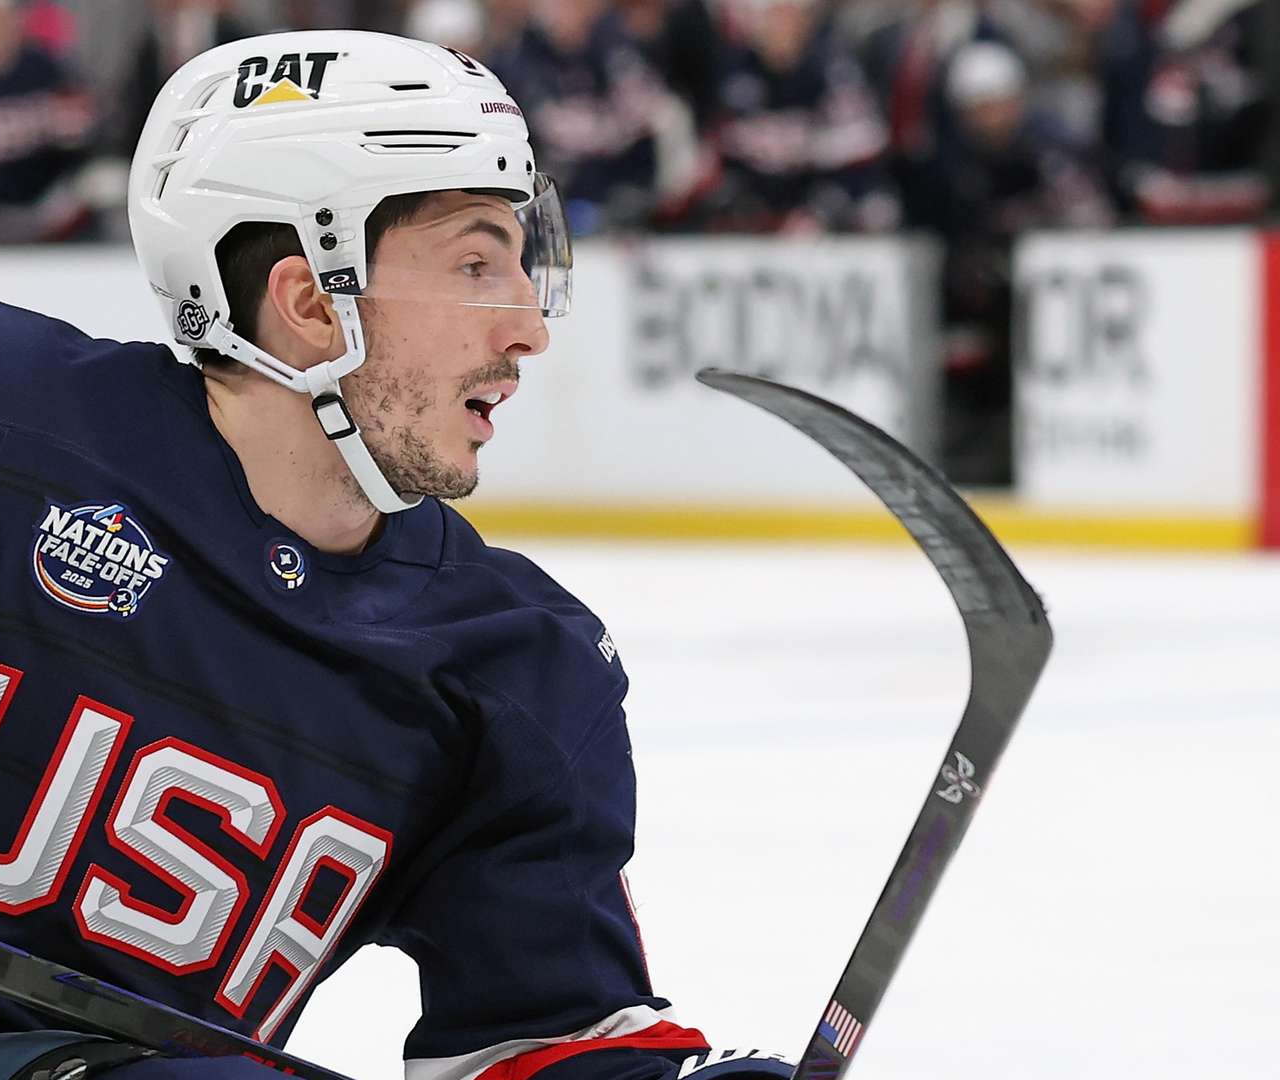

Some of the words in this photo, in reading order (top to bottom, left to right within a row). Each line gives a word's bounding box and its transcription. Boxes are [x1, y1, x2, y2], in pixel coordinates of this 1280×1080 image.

[233, 52, 339, 108] CAT
[40, 505, 168, 579] NATIONS
[40, 534, 147, 590] FACE-OFF
[60, 569, 94, 589] 2025
